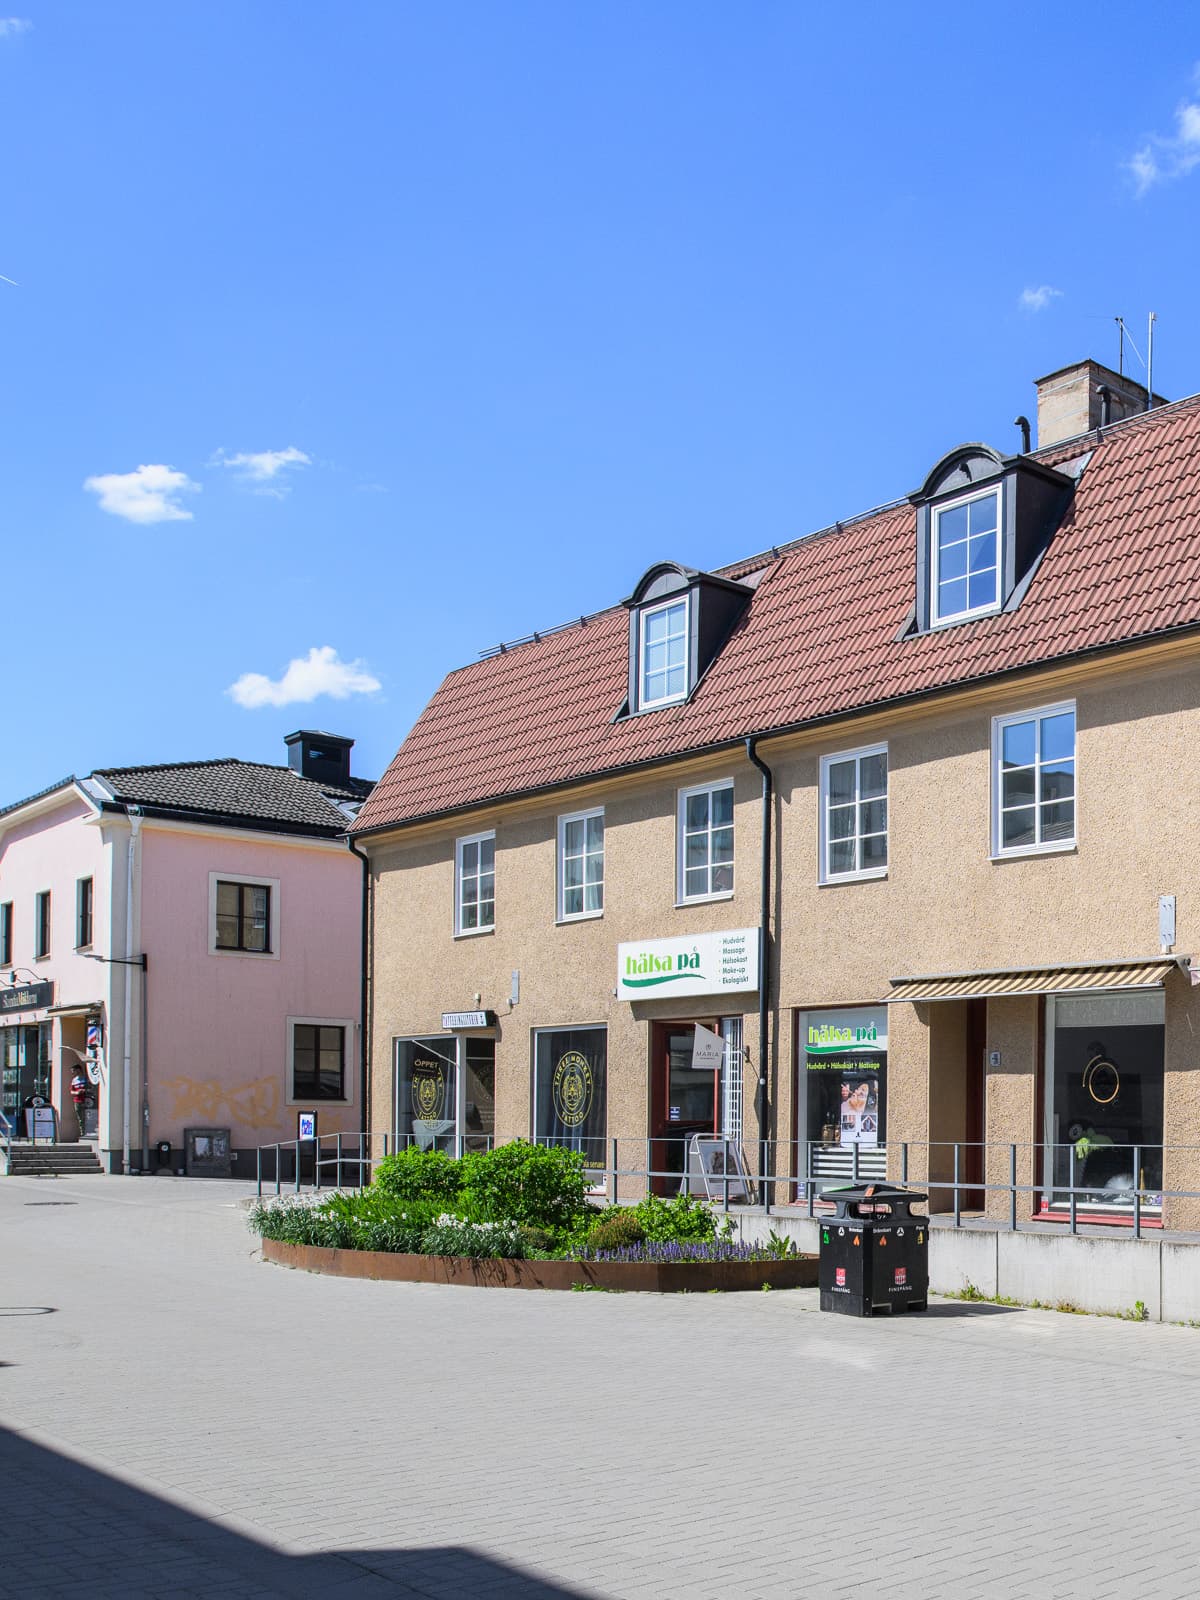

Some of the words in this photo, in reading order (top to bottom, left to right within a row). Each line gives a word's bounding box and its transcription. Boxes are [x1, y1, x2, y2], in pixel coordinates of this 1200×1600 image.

[722, 936, 745, 944] Hudvård
[722, 947, 745, 955] Massage
[626, 952, 672, 975] hälsa
[677, 946, 700, 970] på
[722, 976, 748, 984] Ekologiskt
[808, 1025, 852, 1043] hälsa
[856, 1021, 877, 1041] på
[562, 1111, 584, 1123] TATTOO
